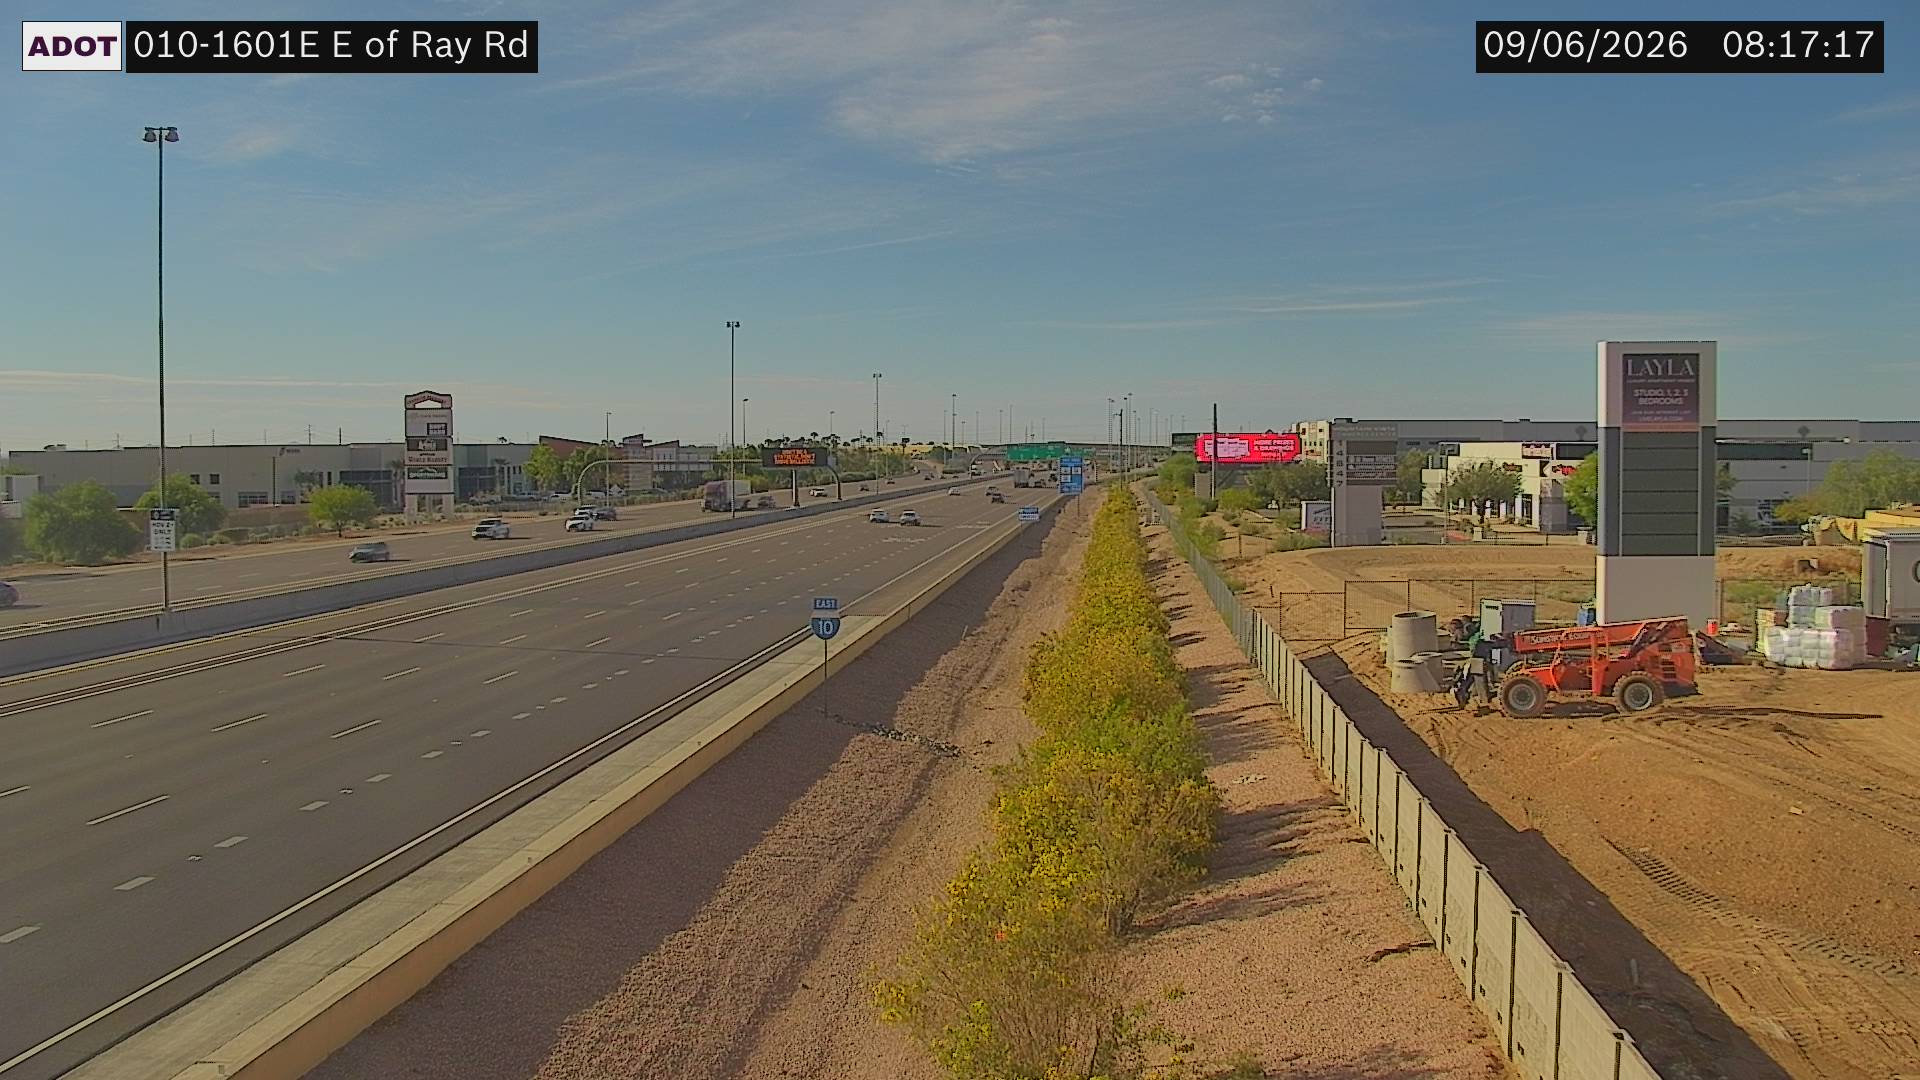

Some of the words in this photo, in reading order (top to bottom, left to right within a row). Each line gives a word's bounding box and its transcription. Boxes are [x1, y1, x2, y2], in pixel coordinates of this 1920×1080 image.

[1627, 359, 1694, 376] LAYLA
[1638, 397, 1684, 405] BEDROOMS
[816, 599, 836, 609] EAST
[819, 620, 834, 635] 10
